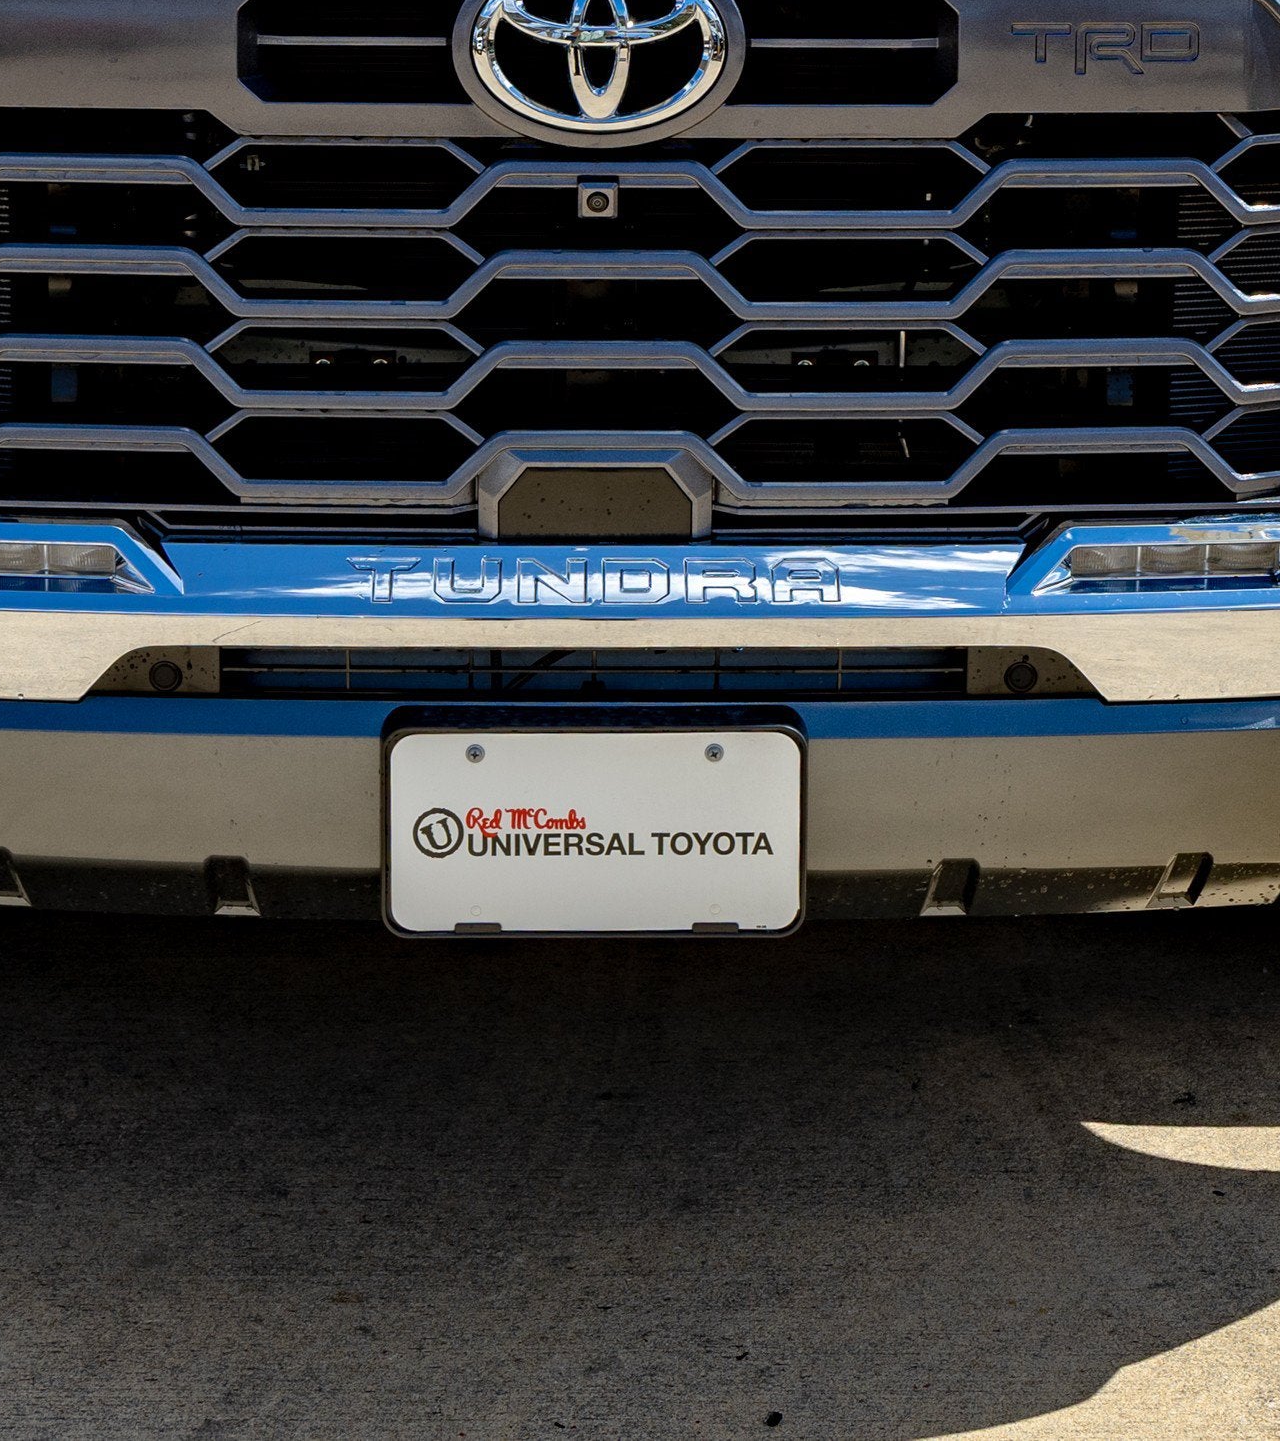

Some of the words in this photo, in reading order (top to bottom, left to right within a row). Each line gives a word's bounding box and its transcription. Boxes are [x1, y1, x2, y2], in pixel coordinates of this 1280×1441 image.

[1011, 21, 1200, 75] TRD
[346, 556, 842, 604] TUNDRA
[466, 807, 502, 838] Red
[505, 808, 587, 830] McCombs
[467, 832, 645, 857] UNIVERSAL
[651, 831, 774, 856] TOYOTA
